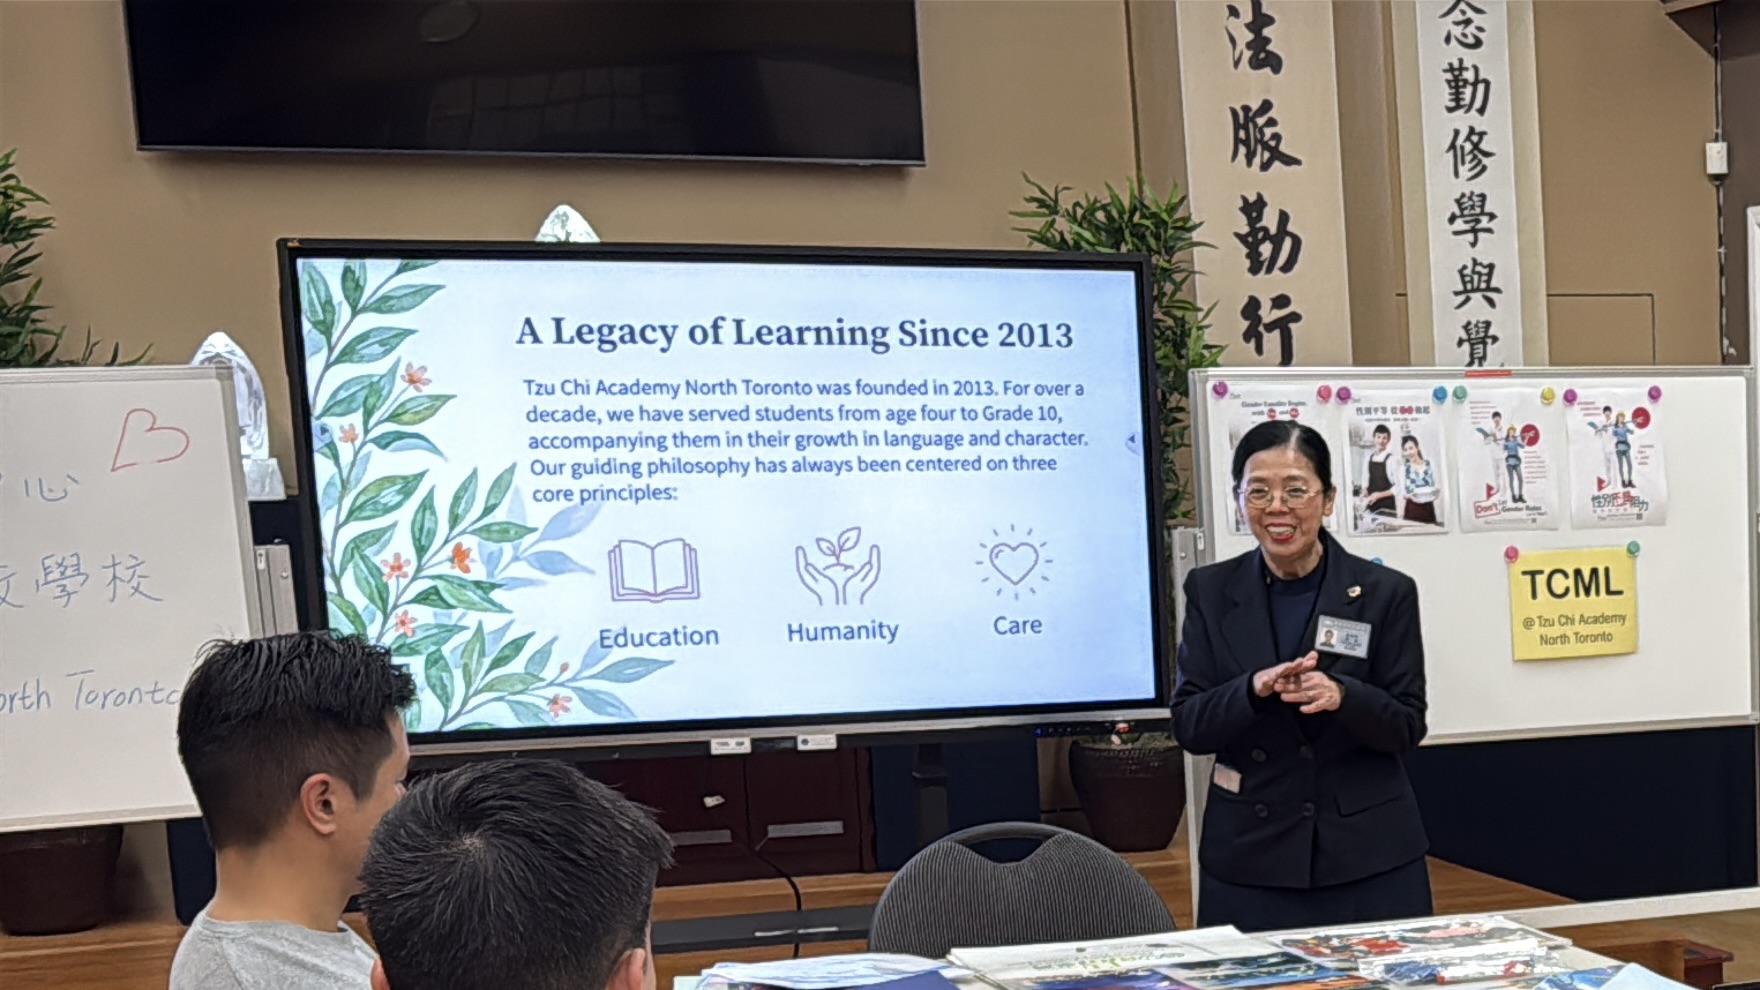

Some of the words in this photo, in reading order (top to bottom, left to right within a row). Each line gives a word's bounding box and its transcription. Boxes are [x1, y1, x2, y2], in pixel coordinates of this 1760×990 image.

[516, 317, 542, 344] A
[552, 318, 678, 353] Legacy
[689, 316, 726, 345] of
[733, 318, 890, 354] Learning
[899, 319, 988, 347] Since
[998, 323, 1072, 347] 2013
[523, 380, 555, 396] Tzu
[561, 379, 590, 396] Chi
[596, 379, 681, 399] Academy
[685, 379, 737, 395] North
[742, 379, 812, 395] Toronto
[817, 383, 851, 395] was
[856, 378, 928, 396] founded
[933, 379, 949, 395] in
[953, 381, 998, 396] 2013.
[1004, 381, 1030, 396] For
[1034, 384, 1071, 396] over
[1075, 384, 1084, 396] a
[526, 405, 602, 425] decade,
[607, 410, 634, 422] we
[639, 405, 683, 421] have
[689, 405, 750, 421] served
[756, 405, 833, 421] students
[838, 404, 880, 421] from
[886, 409, 916, 425] age
[921, 404, 956, 421] four
[960, 407, 978, 421] to
[983, 405, 1033, 421] Grade
[1039, 406, 1062, 423] 10,
[529, 431, 668, 452] accompanying
[672, 431, 720, 448] them
[726, 431, 742, 447] in
[748, 431, 790, 447] their
[795, 430, 858, 451] growth
[863, 430, 879, 446] in
[884, 430, 964, 450] language
[969, 430, 1000, 446] and
[1005, 430, 1088, 446] character.
[531, 459, 566, 475] Our
[571, 458, 643, 480] guiding
[648, 457, 750, 478] philosophy
[755, 457, 787, 473] has
[792, 456, 853, 476] always
[857, 456, 900, 472] been
[906, 455, 981, 472] centered
[987, 459, 1008, 471] on
[1012, 455, 1057, 471] three
[533, 489, 574, 502] core
[580, 484, 677, 506] principles:
[1521, 566, 1624, 600] TCML
[788, 620, 899, 644] Humanity
[994, 616, 1042, 635] Care
[1522, 617, 1535, 630] @
[1537, 614, 1555, 628] Tzu
[1558, 613, 1575, 627] Chi
[1579, 612, 1627, 627] Academy
[600, 626, 719, 649] Education
[1540, 633, 1570, 646] North
[1573, 631, 1614, 644] Toronto
